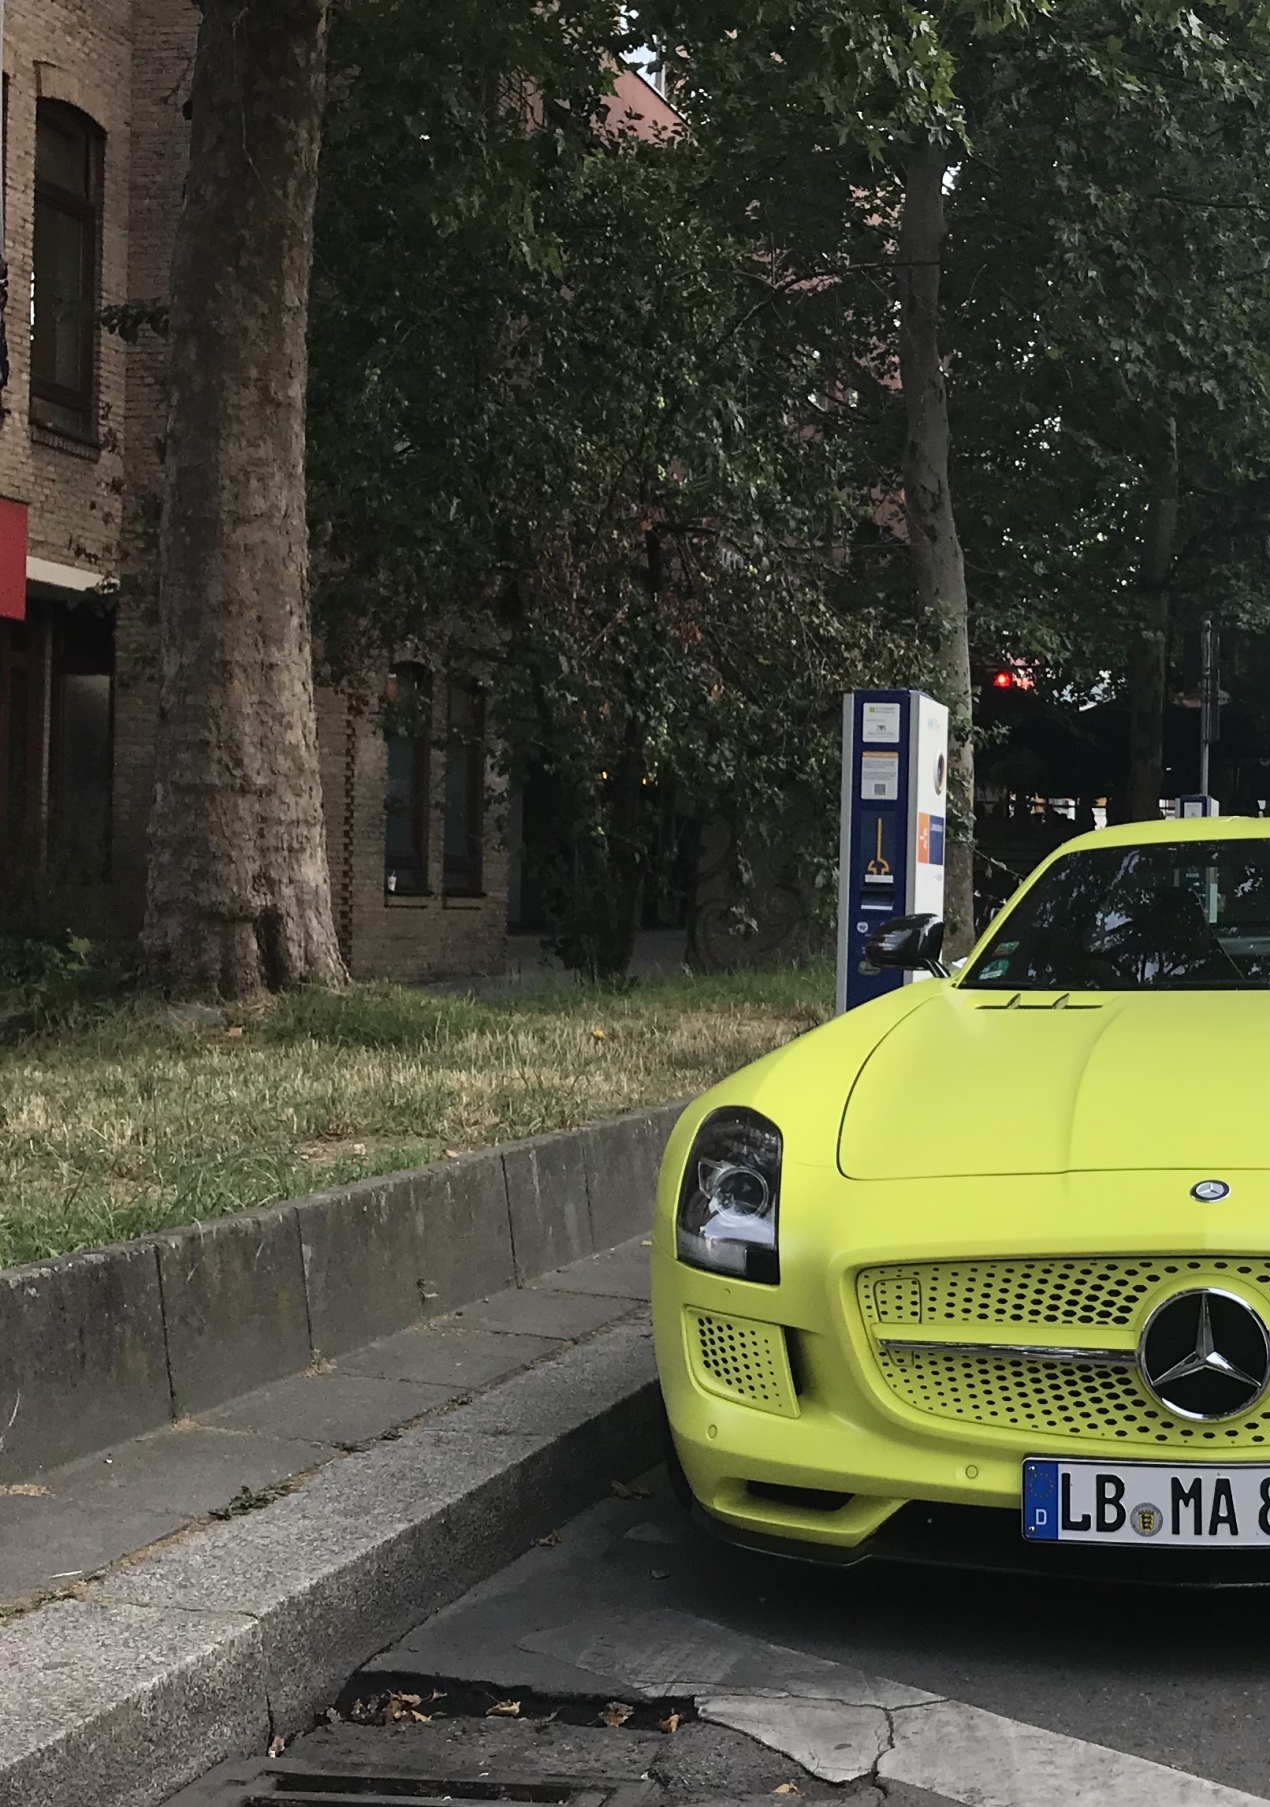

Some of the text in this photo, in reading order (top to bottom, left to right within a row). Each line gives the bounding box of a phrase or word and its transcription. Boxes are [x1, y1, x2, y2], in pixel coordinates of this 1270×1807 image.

[1035, 1508, 1047, 1526] D
[1061, 1472, 1126, 1533] LB
[1171, 1476, 1239, 1537] MA
